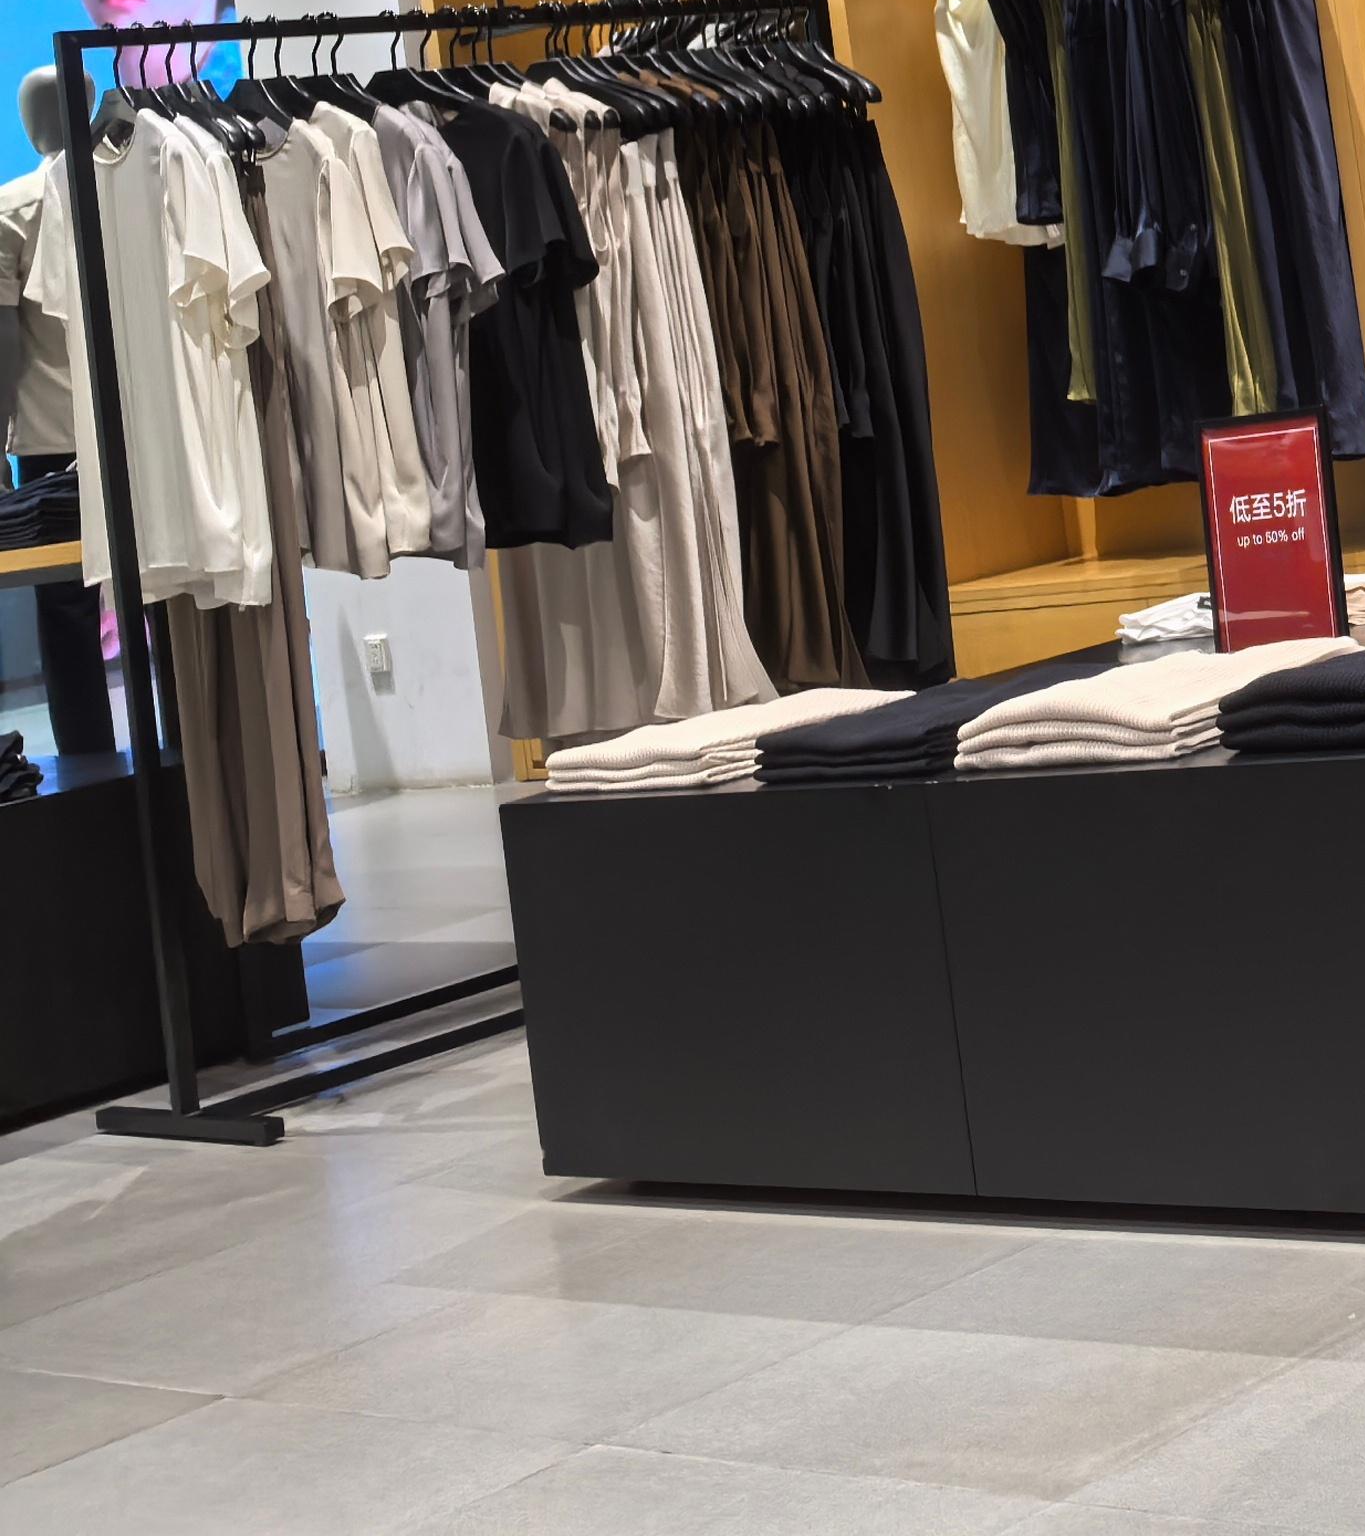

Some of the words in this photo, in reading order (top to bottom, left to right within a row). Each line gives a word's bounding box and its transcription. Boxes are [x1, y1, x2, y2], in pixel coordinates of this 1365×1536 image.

[1229, 488, 1307, 524] 低至5折
[1237, 536, 1250, 548] up
[1252, 534, 1263, 544] to
[1265, 529, 1288, 544] 50%
[1291, 527, 1304, 541] off
